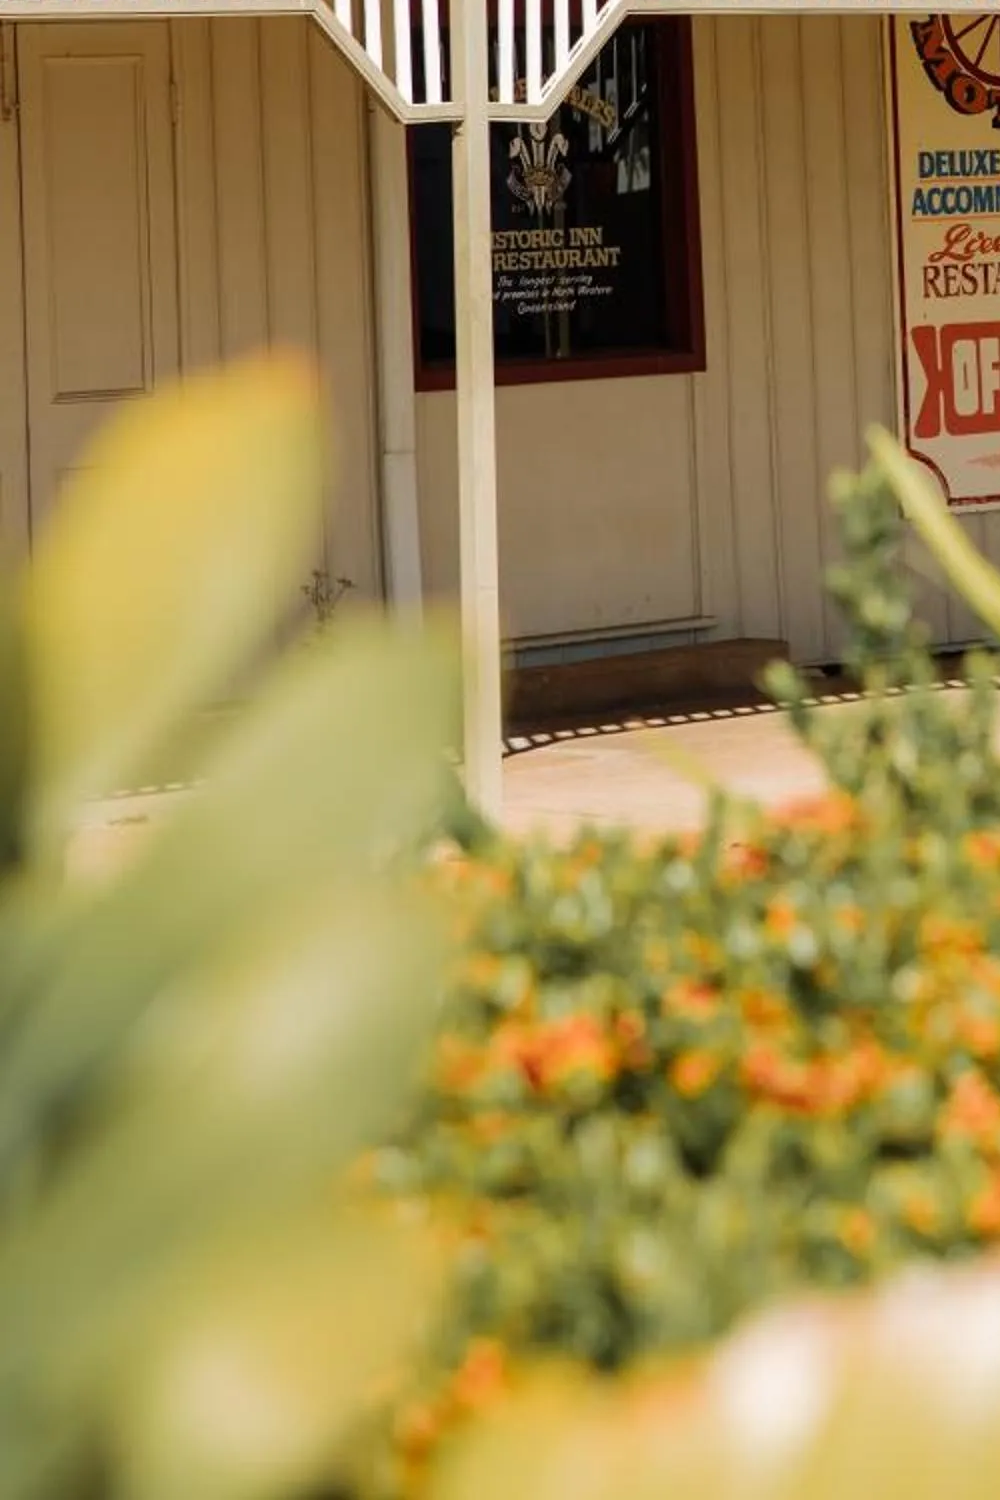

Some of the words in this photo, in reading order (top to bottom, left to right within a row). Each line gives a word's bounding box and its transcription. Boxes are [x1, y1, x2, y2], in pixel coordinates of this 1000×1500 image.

[918, 151, 1000, 178] DELUXE
[491, 229, 564, 250] ISTORIC
[568, 227, 603, 247] INN
[493, 246, 621, 271] RESTAURANT
